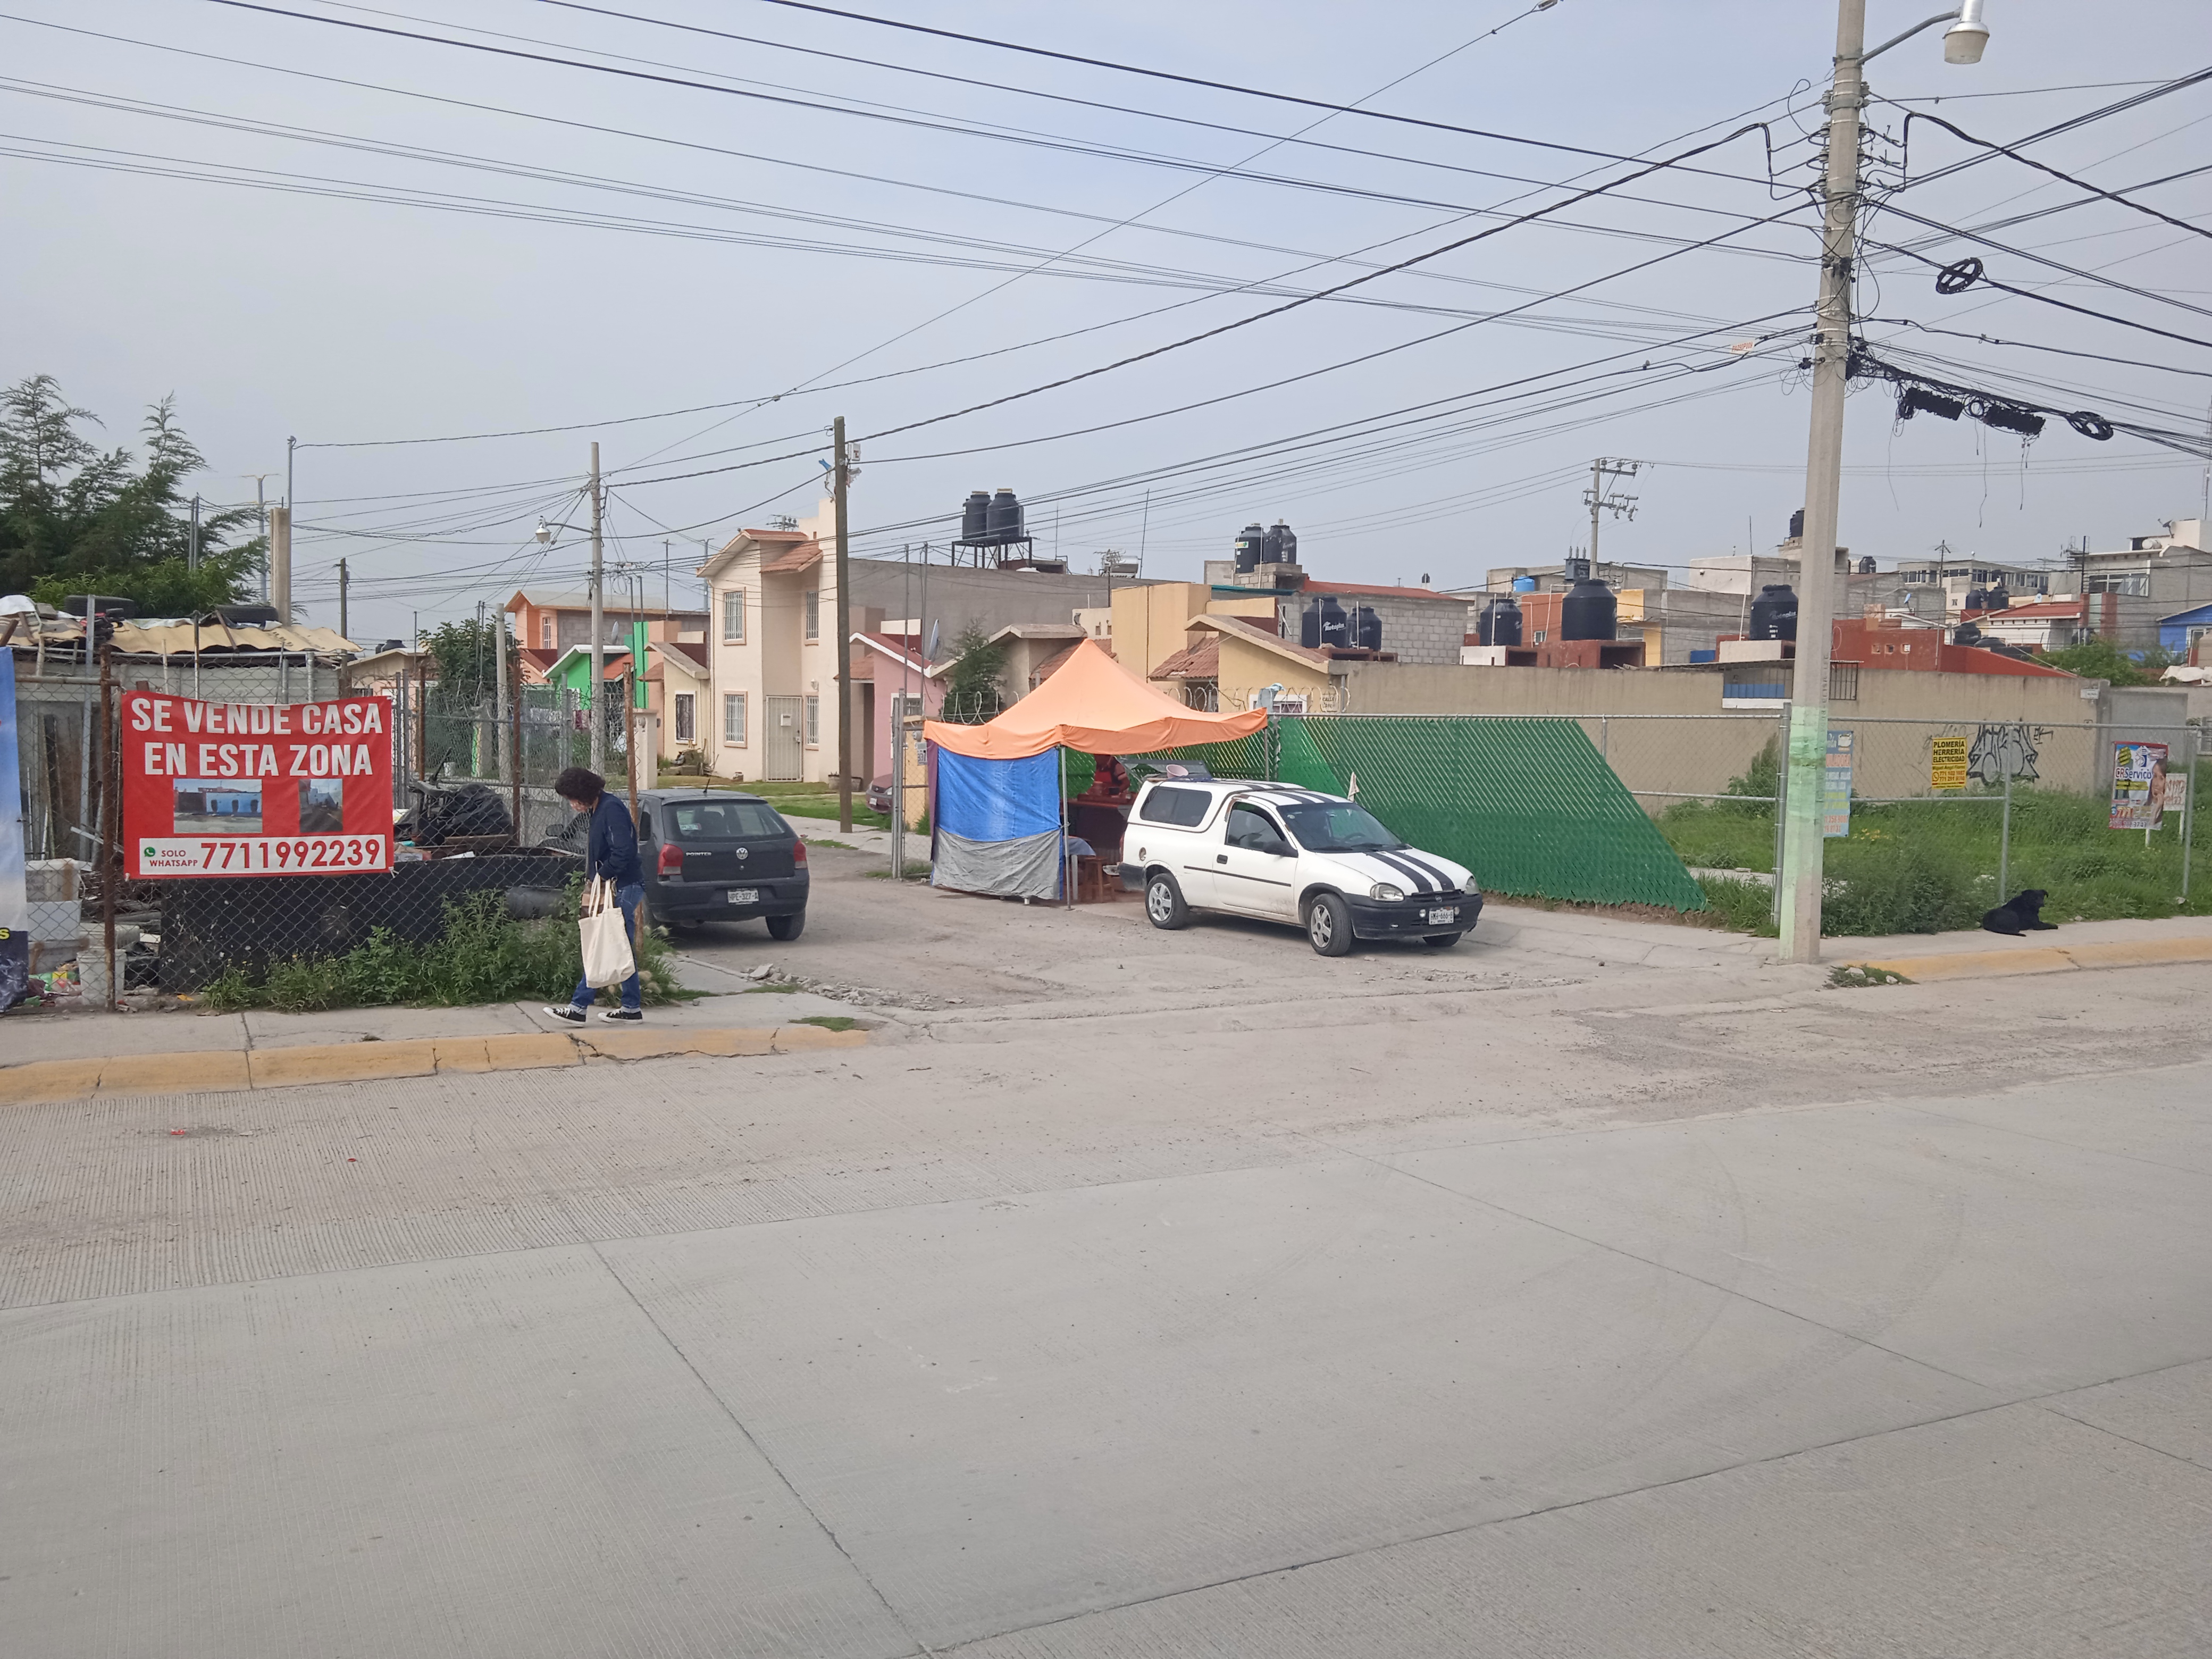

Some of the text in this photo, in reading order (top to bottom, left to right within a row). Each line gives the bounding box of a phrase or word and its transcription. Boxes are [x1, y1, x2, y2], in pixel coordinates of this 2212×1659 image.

[131, 698, 383, 735] SE VENDE CASA
[145, 742, 373, 777] EN ESTA ZONA
[149, 839, 380, 869] WHATSAPP 7711992239
